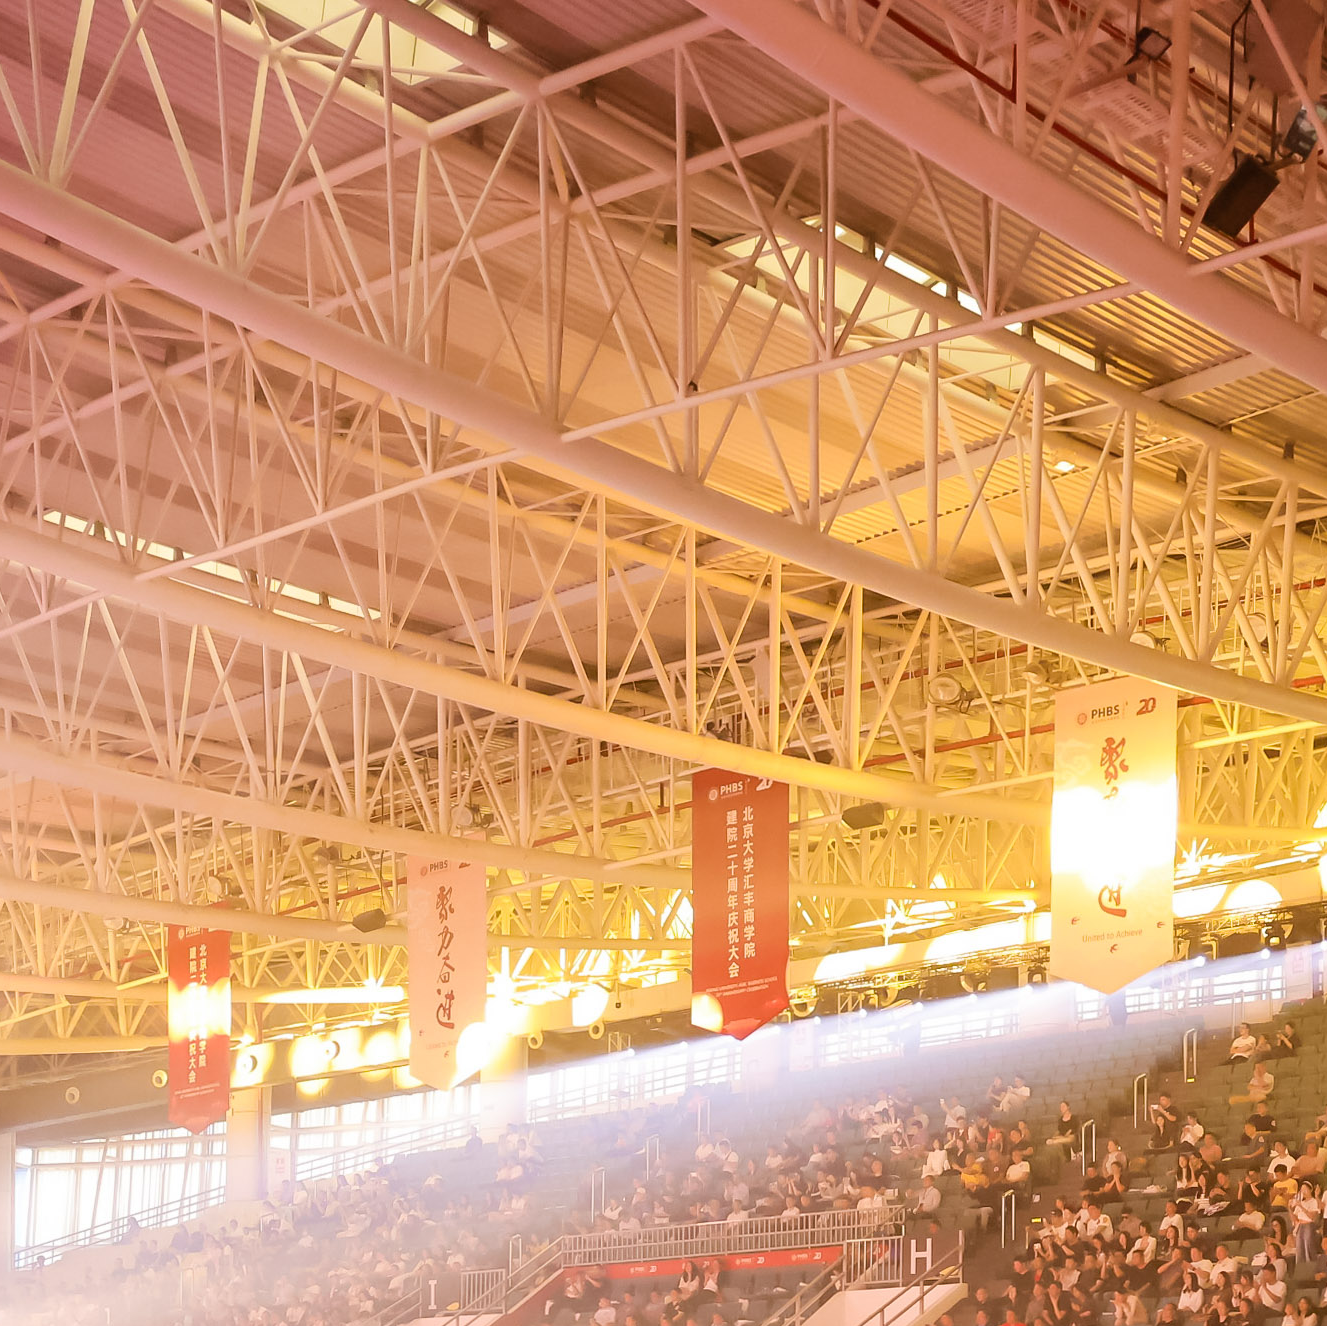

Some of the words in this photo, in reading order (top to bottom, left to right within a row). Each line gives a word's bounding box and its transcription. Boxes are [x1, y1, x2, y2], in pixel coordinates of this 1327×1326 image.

[1090, 704, 1121, 719] PHBS
[1136, 697, 1157, 716] 20
[720, 781, 743, 795] PHBS
[429, 860, 448, 872] PHBS
[742, 805, 756, 958] 北京大学汇丰商学院
[726, 810, 740, 978] 建院二十周年庆祝大会
[1082, 931, 1106, 943] United
[1116, 928, 1143, 939] Achieve
[910, 1237, 932, 1275] H
